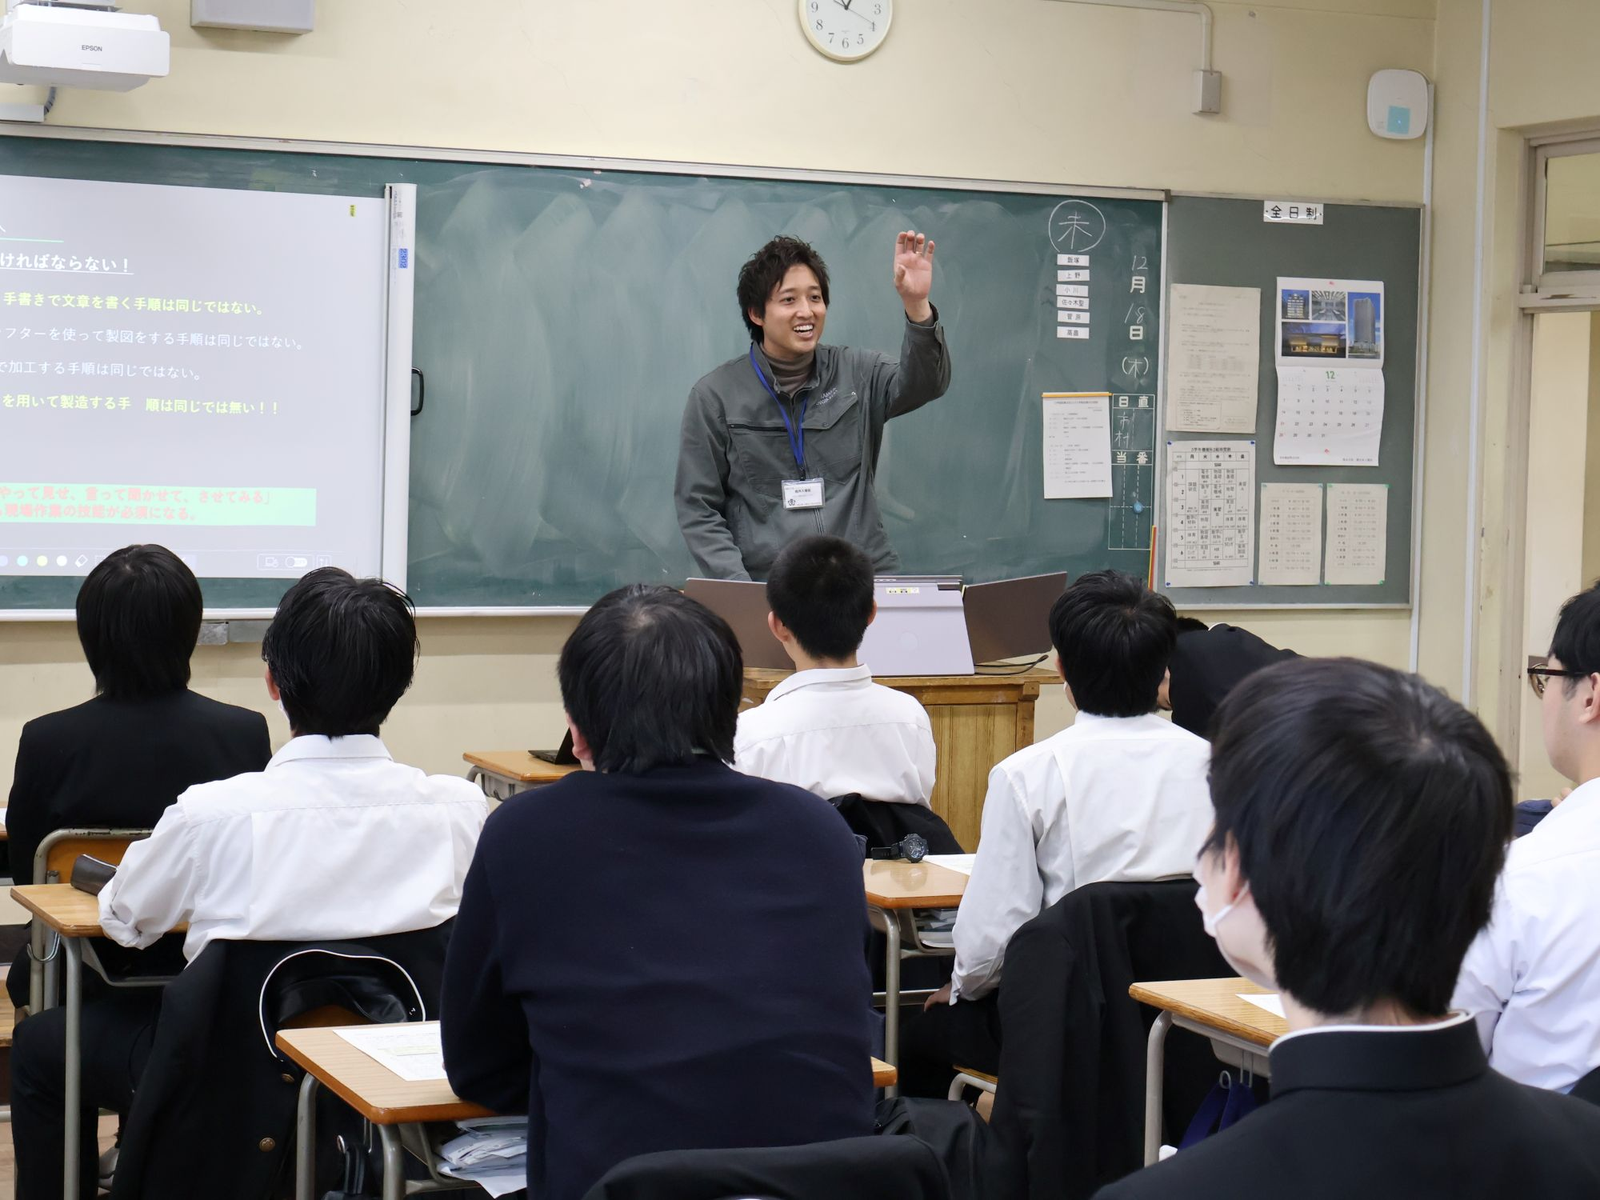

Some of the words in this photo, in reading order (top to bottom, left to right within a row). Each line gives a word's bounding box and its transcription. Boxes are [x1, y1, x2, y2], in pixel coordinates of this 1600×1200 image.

[811, 1, 818, 13] 9
[874, 4, 881, 15] 3
[815, 19, 823, 30] 8
[869, 22, 876, 32] 4
[828, 32, 835, 43] 7
[841, 37, 849, 49] 6
[857, 33, 864, 45] 5
[1271, 205, 1317, 220] 全日制
[0, 253, 128, 273] ければならない！
[1132, 255, 1148, 271] 12
[1130, 276, 1146, 294] 月
[4, 292, 262, 316] 手書きで文章を書く手順は同じではない。
[0, 327, 302, 350] フターを使って製図をする手順は同じではない。
[1129, 325, 1144, 340] 日
[0, 360, 200, 381] で加工する手順は同じではない。
[1325, 371, 1336, 380] 12
[2, 394, 131, 410] を用いて製造する手
[145, 398, 278, 415] 順は同じでは無い！！
[1119, 395, 1149, 408] 日直
[1117, 451, 1149, 465] 当番
[0, 502, 196, 521] 現場作業の技能が必須になる。
